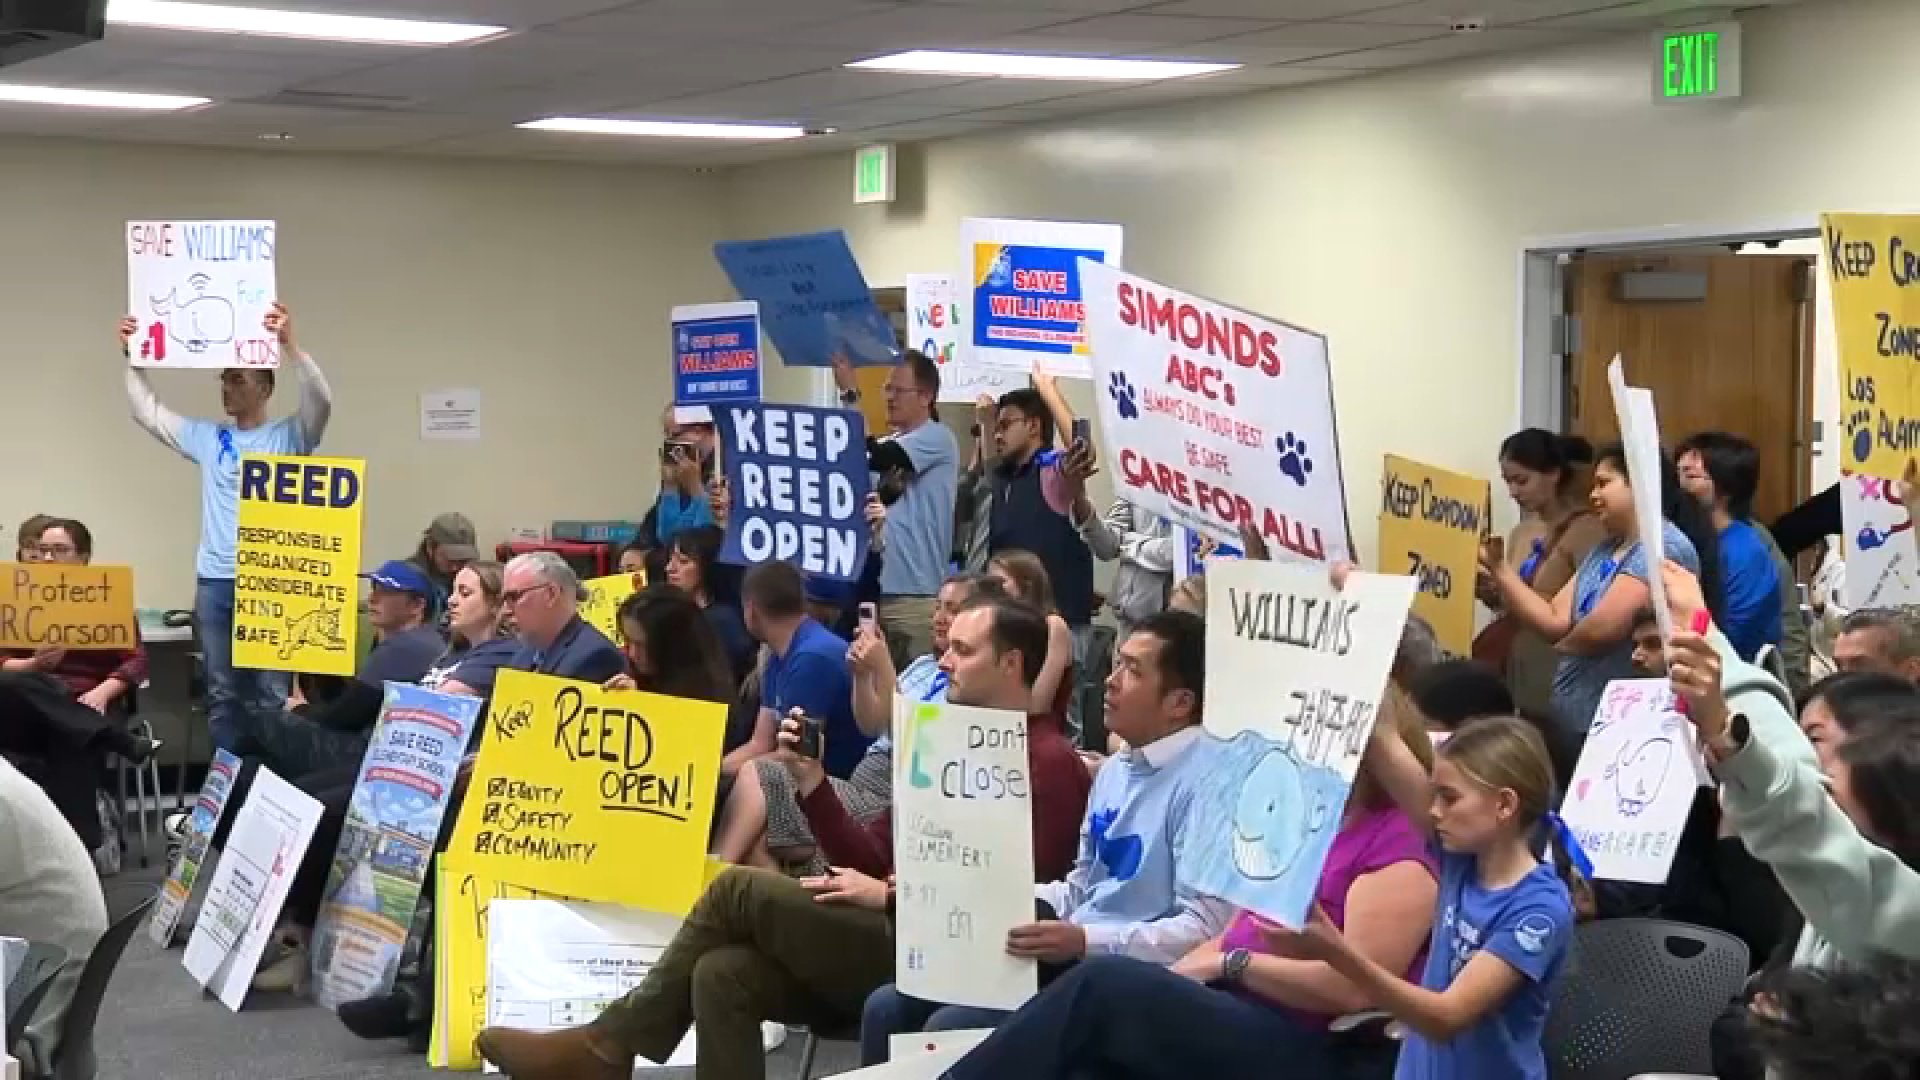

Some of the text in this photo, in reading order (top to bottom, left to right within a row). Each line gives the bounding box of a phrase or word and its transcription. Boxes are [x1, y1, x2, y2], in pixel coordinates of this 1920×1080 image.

[1664, 32, 1718, 96] EXIT
[131, 223, 273, 261] SAVE WILLIAMS
[1827, 225, 1876, 281] KEEP
[1014, 271, 1066, 294] SAVE
[990, 296, 1086, 321] WILLIAMS
[141, 322, 166, 361] #1
[1118, 281, 1281, 377] SIMONDS
[1875, 312, 1920, 361] ZONE
[235, 338, 278, 364] KIDS
[680, 351, 755, 374] WILLIAMS
[1847, 368, 1875, 405] LOS
[730, 408, 849, 462] KEEP
[241, 459, 360, 509] REED
[741, 462, 854, 520] REED
[1120, 449, 1192, 506] CARE
[1194, 479, 1255, 530] FOR
[237, 527, 342, 552] RESPONSIBLE
[741, 516, 856, 577] OPEN
[237, 550, 332, 576] ORGANIZED
[14, 569, 113, 602] Protect
[236, 574, 346, 602] CONSIDERATE
[2, 604, 19, 640] R
[236, 598, 283, 618] KIND
[1229, 587, 1360, 656] WILLIAMS
[236, 625, 279, 645] SAFE
[554, 686, 653, 771] REED
[508, 781, 563, 804] EQUITY
[600, 762, 694, 811] OPEN!
[499, 803, 573, 832] SAFETY
[492, 833, 597, 864] COMMUNITY
